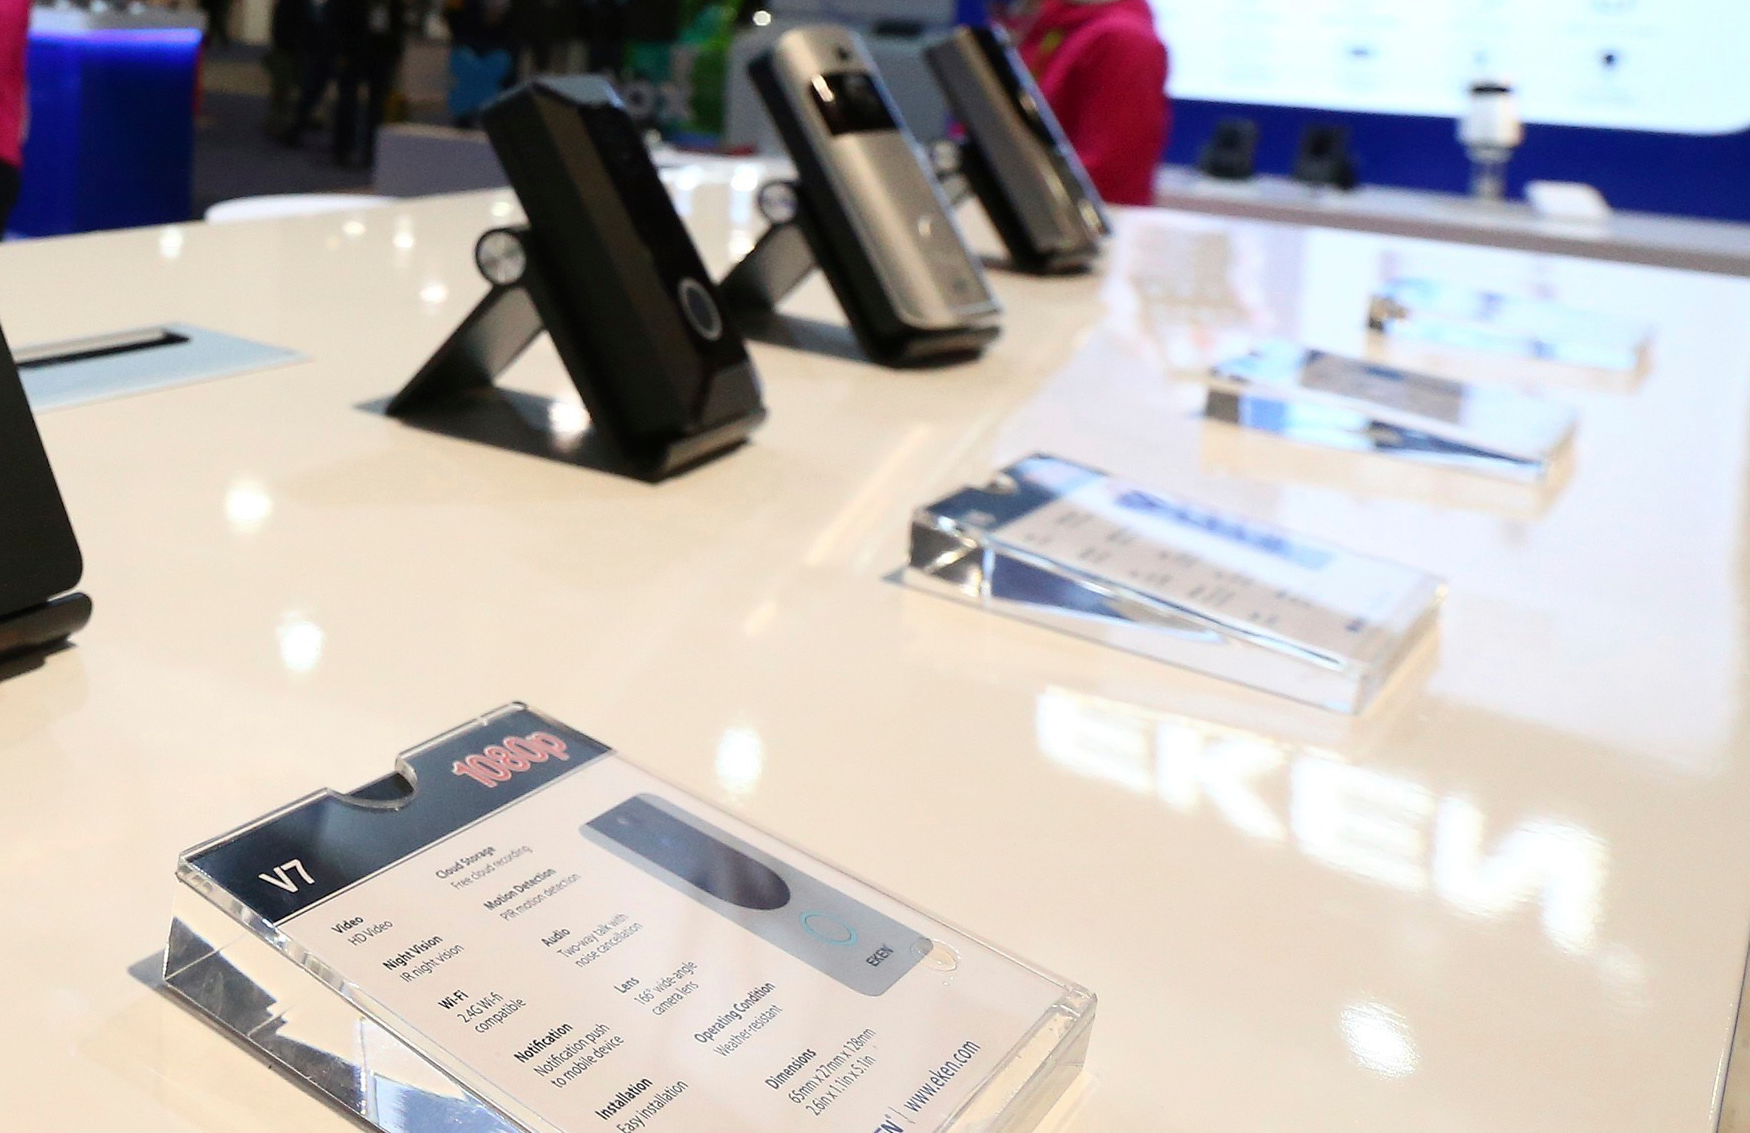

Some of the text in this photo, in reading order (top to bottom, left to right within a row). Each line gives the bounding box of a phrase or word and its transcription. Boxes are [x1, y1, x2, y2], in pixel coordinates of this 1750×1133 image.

[452, 731, 569, 787] 1080p
[258, 858, 315, 893] V7
[435, 846, 496, 880] Cloud Storage
[450, 844, 534, 890] Free cloud recording
[483, 868, 556, 911] Motion Detection
[499, 873, 582, 921] PIR motion detection
[331, 916, 364, 934] Video
[347, 920, 394, 946] HD Video
[541, 927, 571, 948] Audio
[556, 912, 630, 959] Two-way talk with
[575, 921, 644, 968] noise cancellation
[382, 935, 444, 971] Night Vision
[399, 943, 465, 983] IR night vision
[865, 943, 895, 967] EKEN
[613, 975, 640, 994] Lens
[652, 959, 698, 993] wide-angle
[438, 989, 469, 1010] Wi-Fi
[457, 991, 504, 1023] 2.4G Wi-fi
[474, 997, 527, 1034] compatible
[651, 979, 699, 1017] camera lens
[694, 981, 776, 1044] Operating Condition
[513, 1022, 573, 1063] Notification
[533, 1022, 611, 1077] Notification push
[713, 1003, 784, 1057] Weather-resistant
[550, 1033, 625, 1089] to mobile device
[765, 1047, 817, 1090] Dimensions
[788, 1078, 818, 1105] 65mm
[815, 1053, 848, 1079] 27mm
[843, 1027, 877, 1054] 128mm
[903, 1039, 982, 1113] www.eken.com
[594, 1076, 653, 1120] Installation
[636, 1079, 689, 1120] installation
[806, 1095, 832, 1117] 2.6in
[834, 1072, 855, 1095] 1.1in
[853, 1054, 877, 1075] 5.1in
